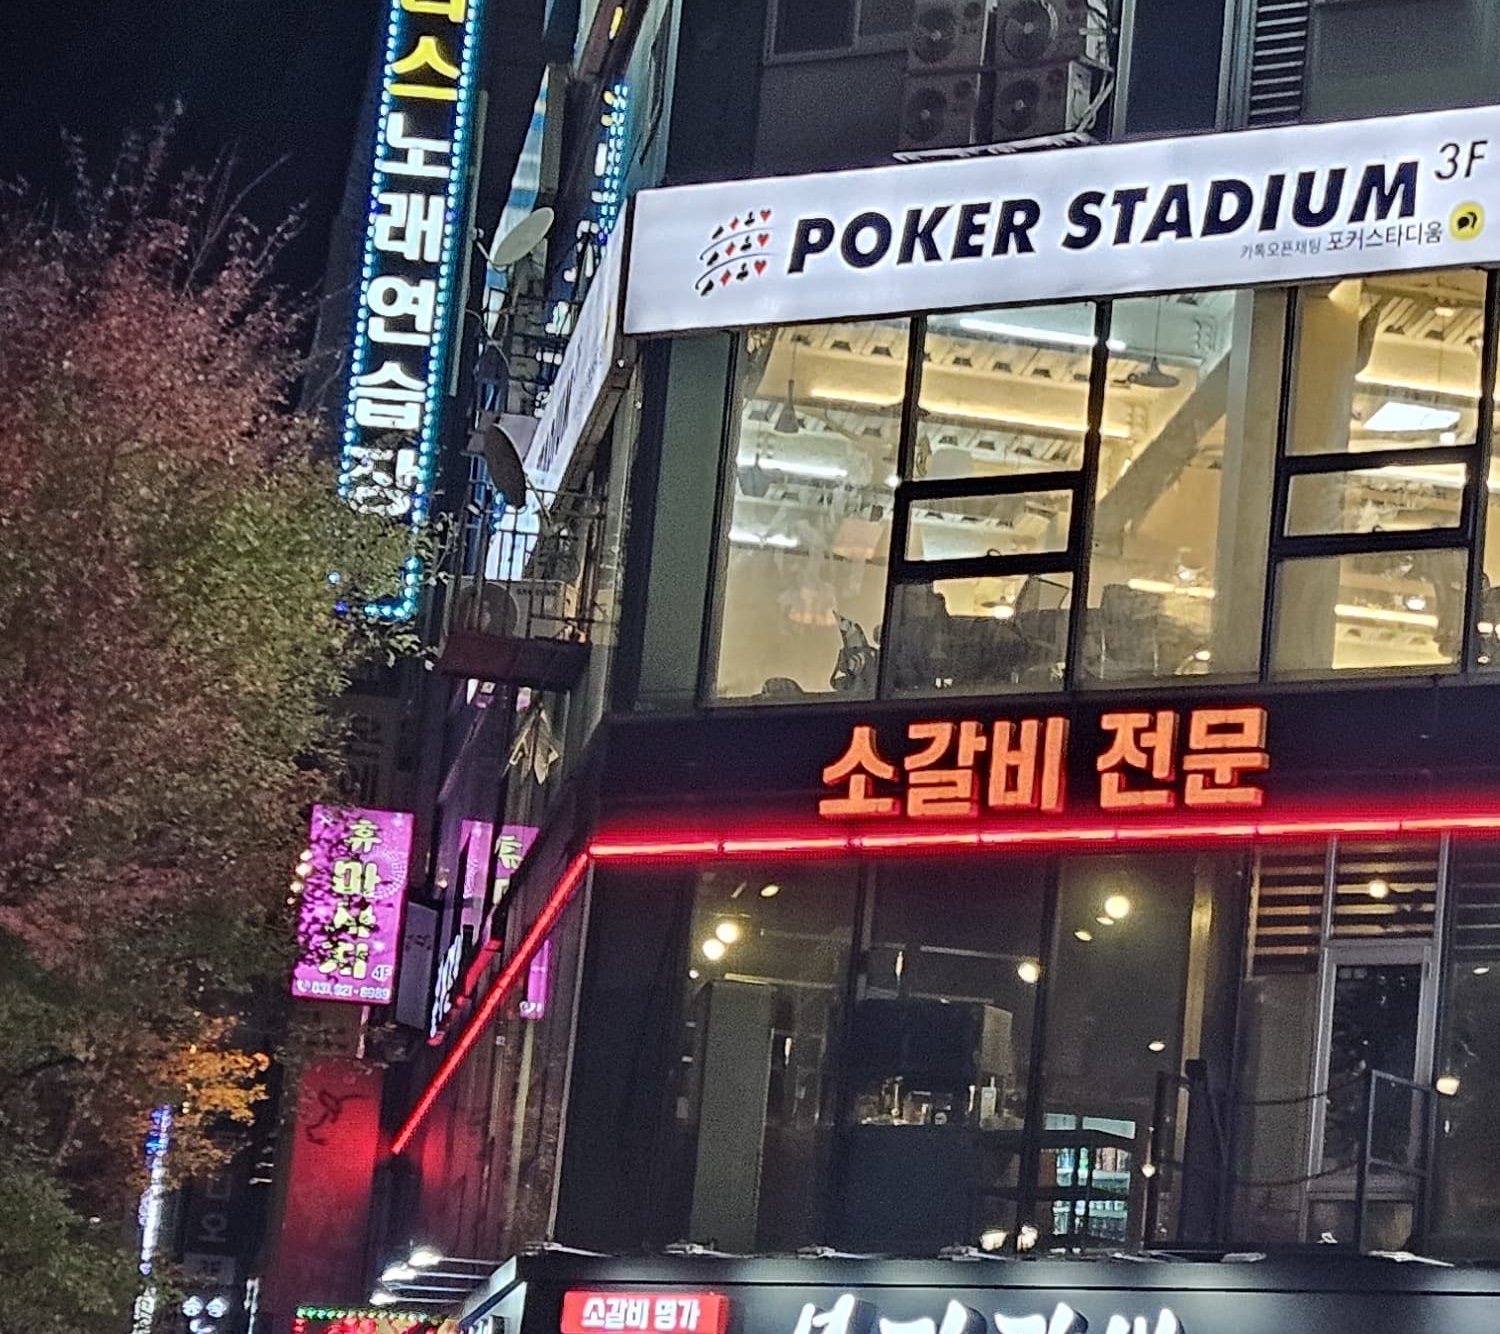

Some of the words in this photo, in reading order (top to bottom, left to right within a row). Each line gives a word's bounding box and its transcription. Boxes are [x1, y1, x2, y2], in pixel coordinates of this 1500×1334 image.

[787, 198, 1042, 275] POKER
[1061, 161, 1419, 249] STADIUM
[1435, 140, 1490, 181] 3F
[1240, 235, 1322, 259] 카톡오픈채팅
[1326, 218, 1445, 254] 포커스타디움
[819, 716, 1070, 819] 소갈비
[1097, 707, 1272, 810] 전문
[581, 1298, 650, 1330] 소갈비
[653, 1298, 700, 1332] 명가
